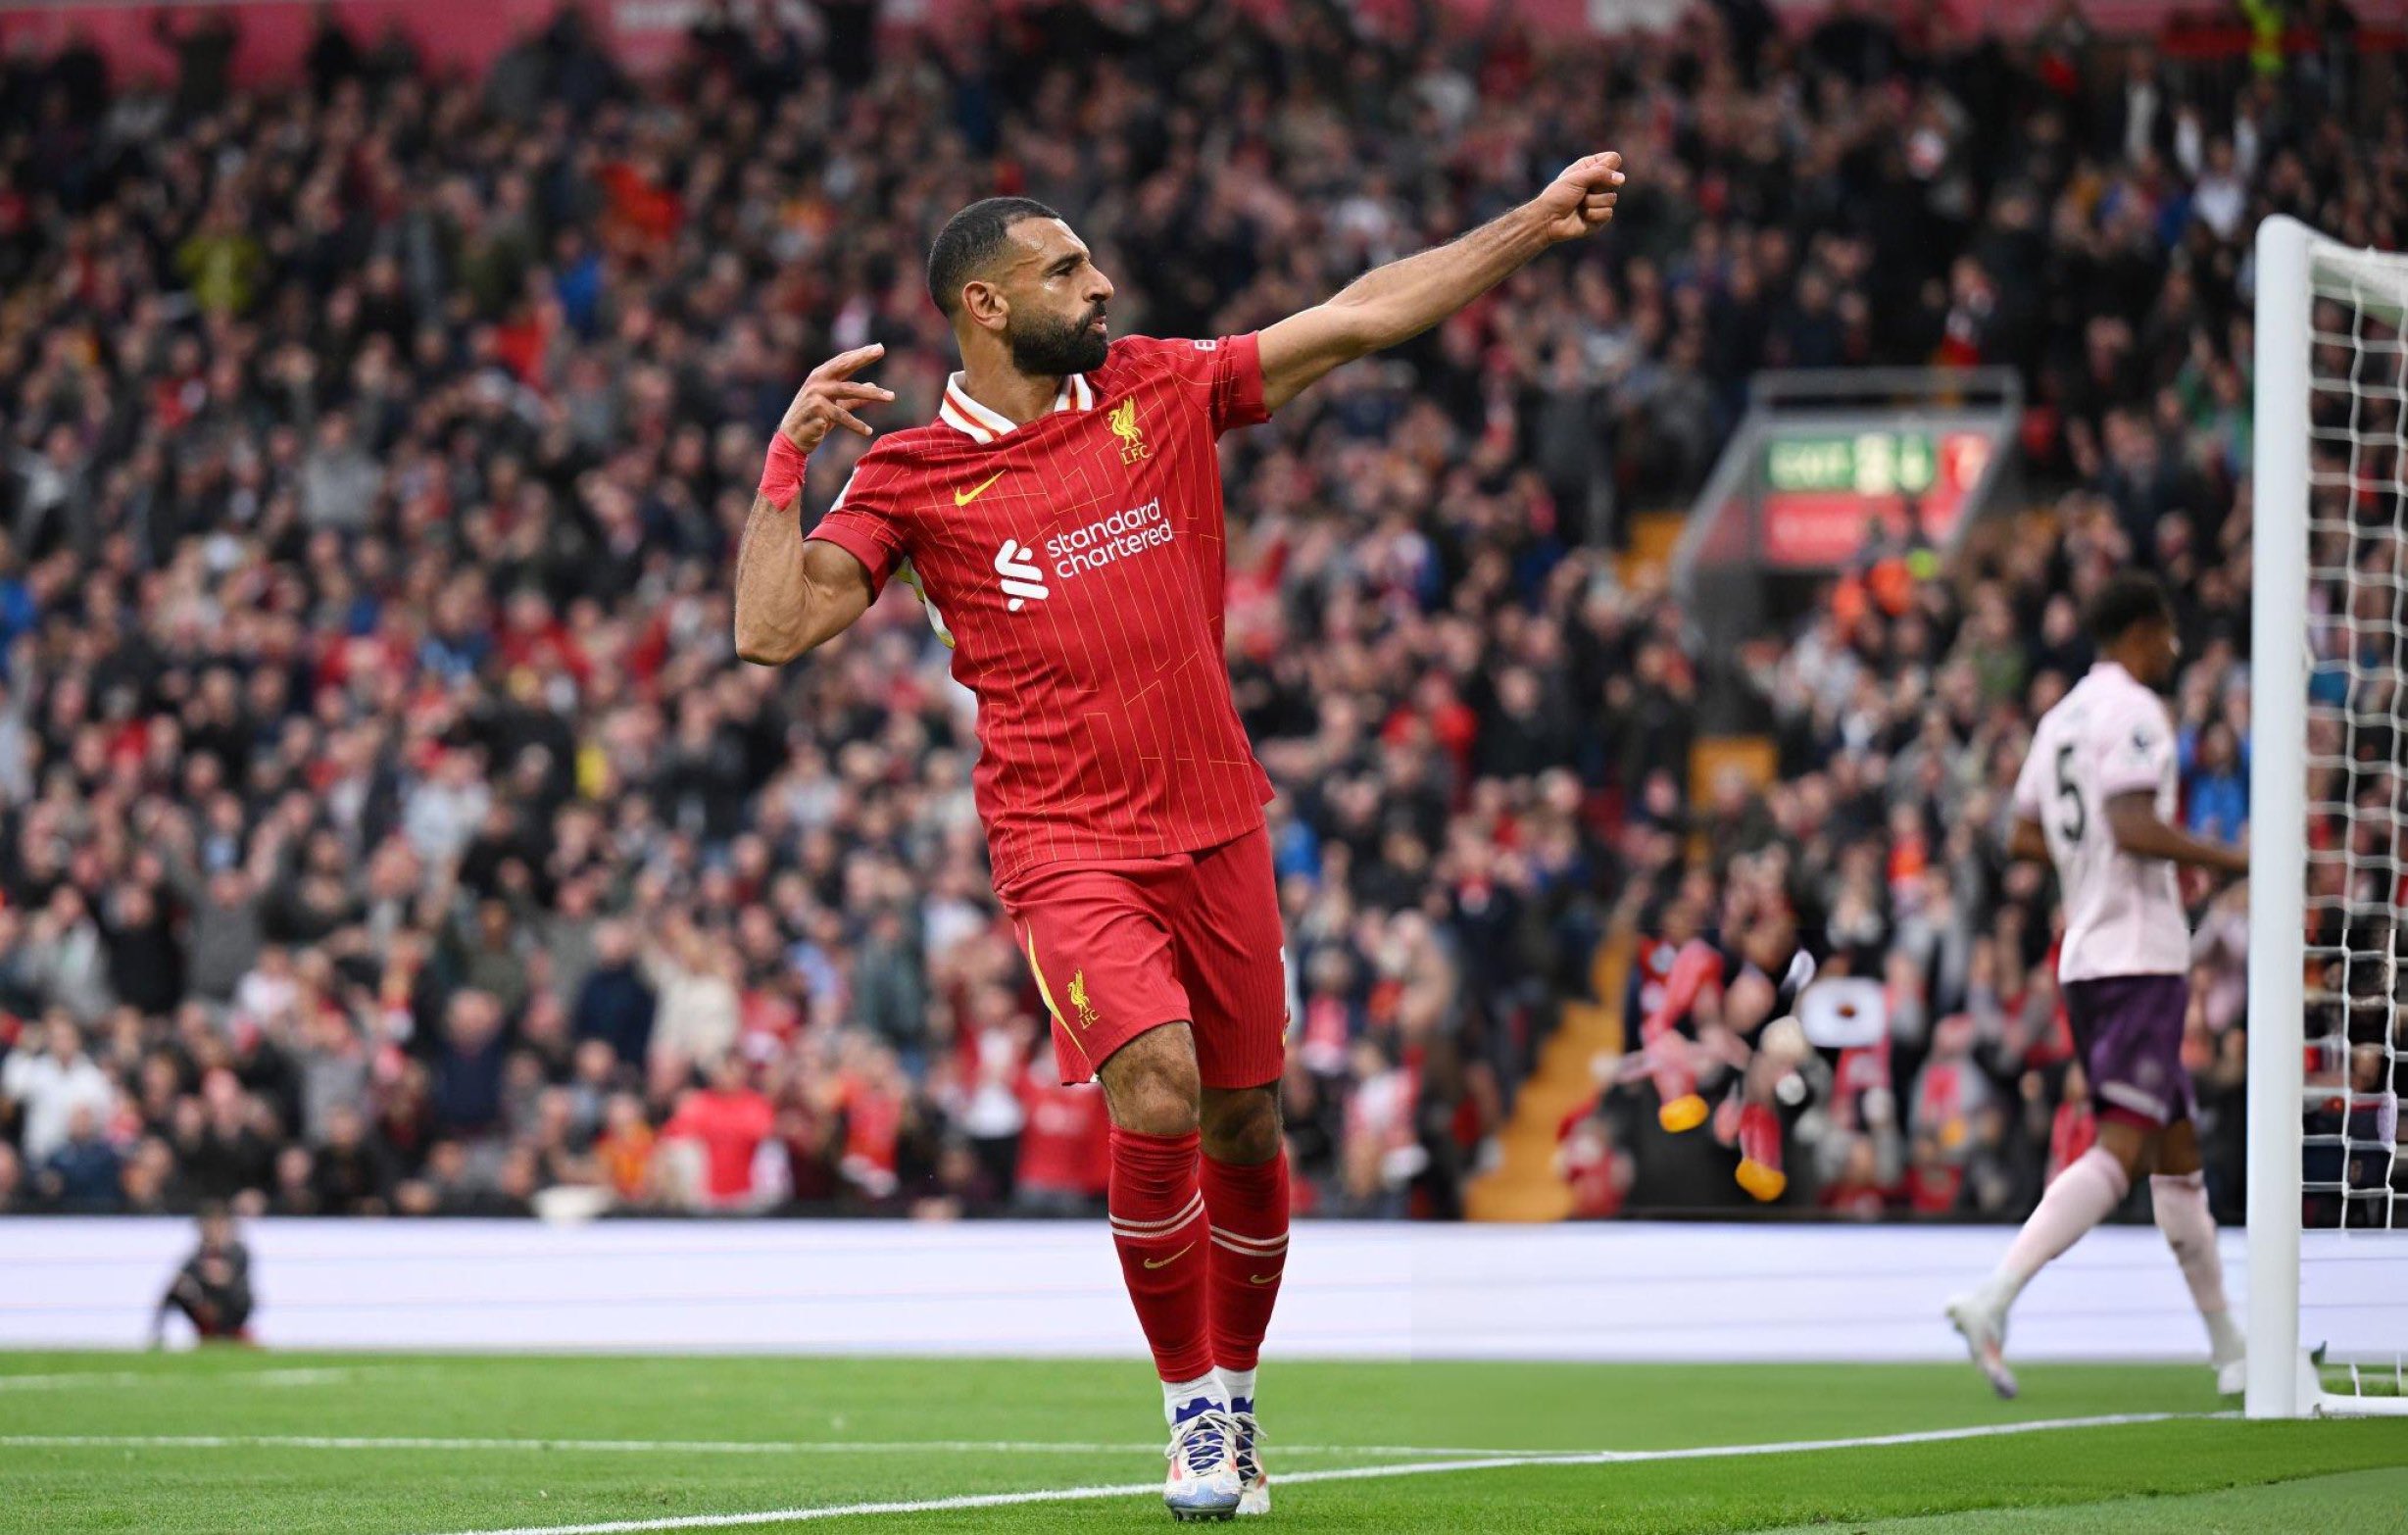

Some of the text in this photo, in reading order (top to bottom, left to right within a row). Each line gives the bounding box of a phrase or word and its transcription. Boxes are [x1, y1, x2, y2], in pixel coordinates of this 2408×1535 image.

[1047, 496, 1160, 559] standard
[1056, 519, 1173, 578] chartered
[2056, 741, 2087, 843] 5
